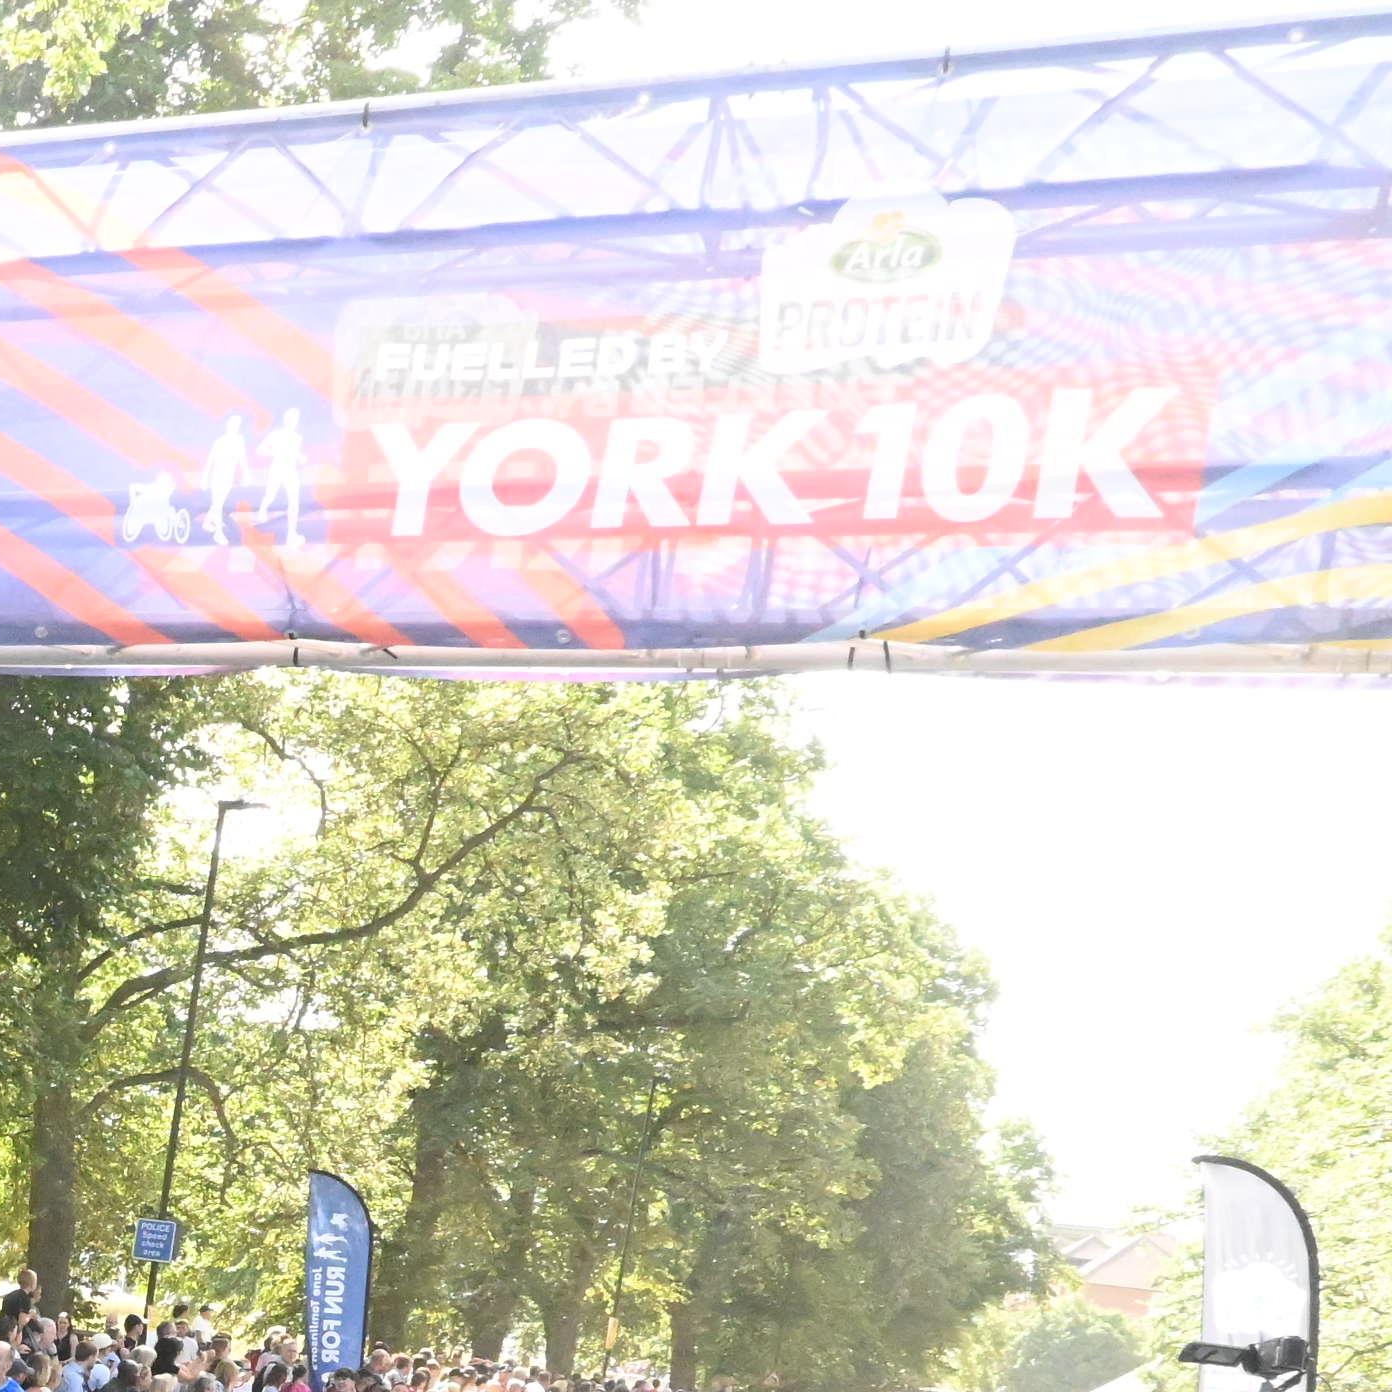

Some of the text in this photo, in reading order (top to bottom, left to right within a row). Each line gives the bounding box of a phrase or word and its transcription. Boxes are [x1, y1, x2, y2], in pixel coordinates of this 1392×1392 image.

[846, 242, 925, 273] Arla
[776, 291, 981, 351] PROTEIN
[375, 329, 729, 381] FUELLED BY
[370, 386, 1181, 537] YORK 10K
[142, 1223, 170, 1232] POLICE
